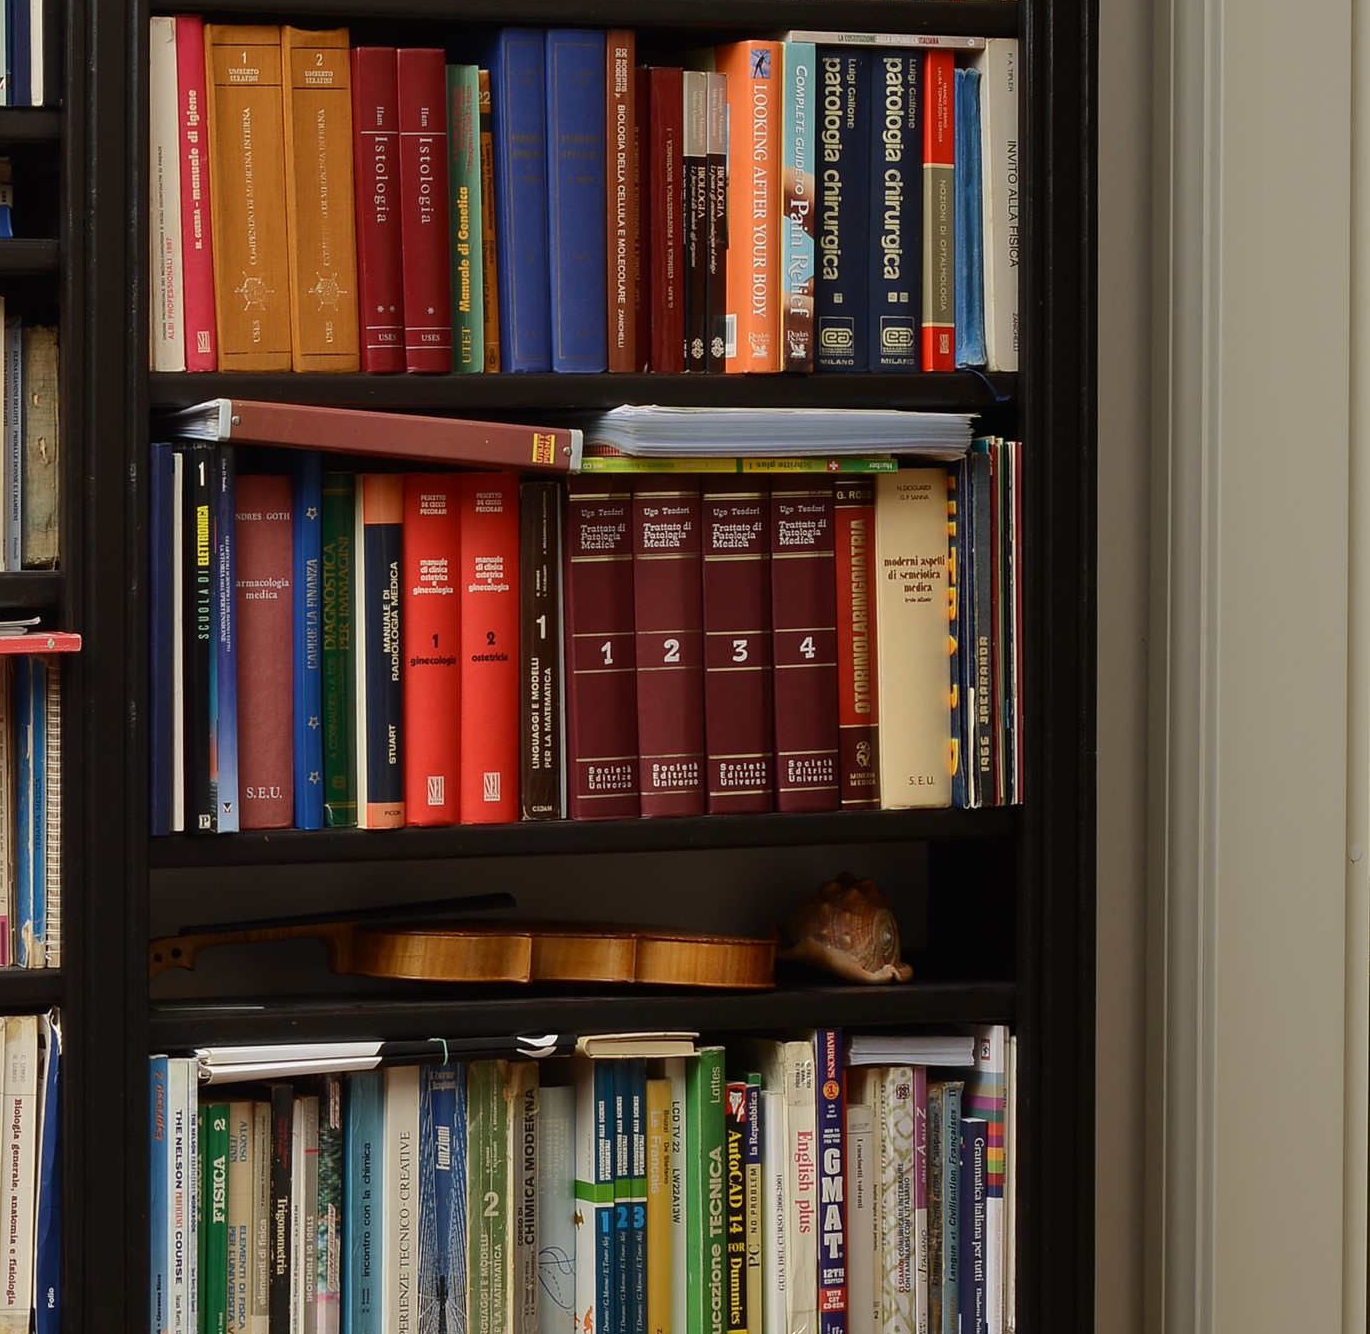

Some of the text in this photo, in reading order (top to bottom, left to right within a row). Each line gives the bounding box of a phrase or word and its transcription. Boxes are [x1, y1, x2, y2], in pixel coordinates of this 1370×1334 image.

[373, 136, 389, 223] Istologia
[821, 58, 841, 281] patologia chirurgica
[752, 85, 767, 317] LOOKING AFTER YOUR BODY
[457, 187, 470, 312] Manuale di Genetica
[197, 505, 209, 639] SCUOLA DI ELETTRONICA
[410, 655, 457, 666] ginecologia
[472, 653, 508, 662] ostetricia
[600, 642, 614, 665] 1
[663, 639, 680, 662] 2
[732, 639, 748, 661] 3
[800, 637, 815, 658] 4
[389, 724, 397, 764] STUART
[246, 787, 283, 799] S.E.U.
[212, 1155, 225, 1223] FISICA
[795, 1131, 814, 1233] English plus
[728, 1130, 745, 1324] AutoCAD 14 FOR Dummies
